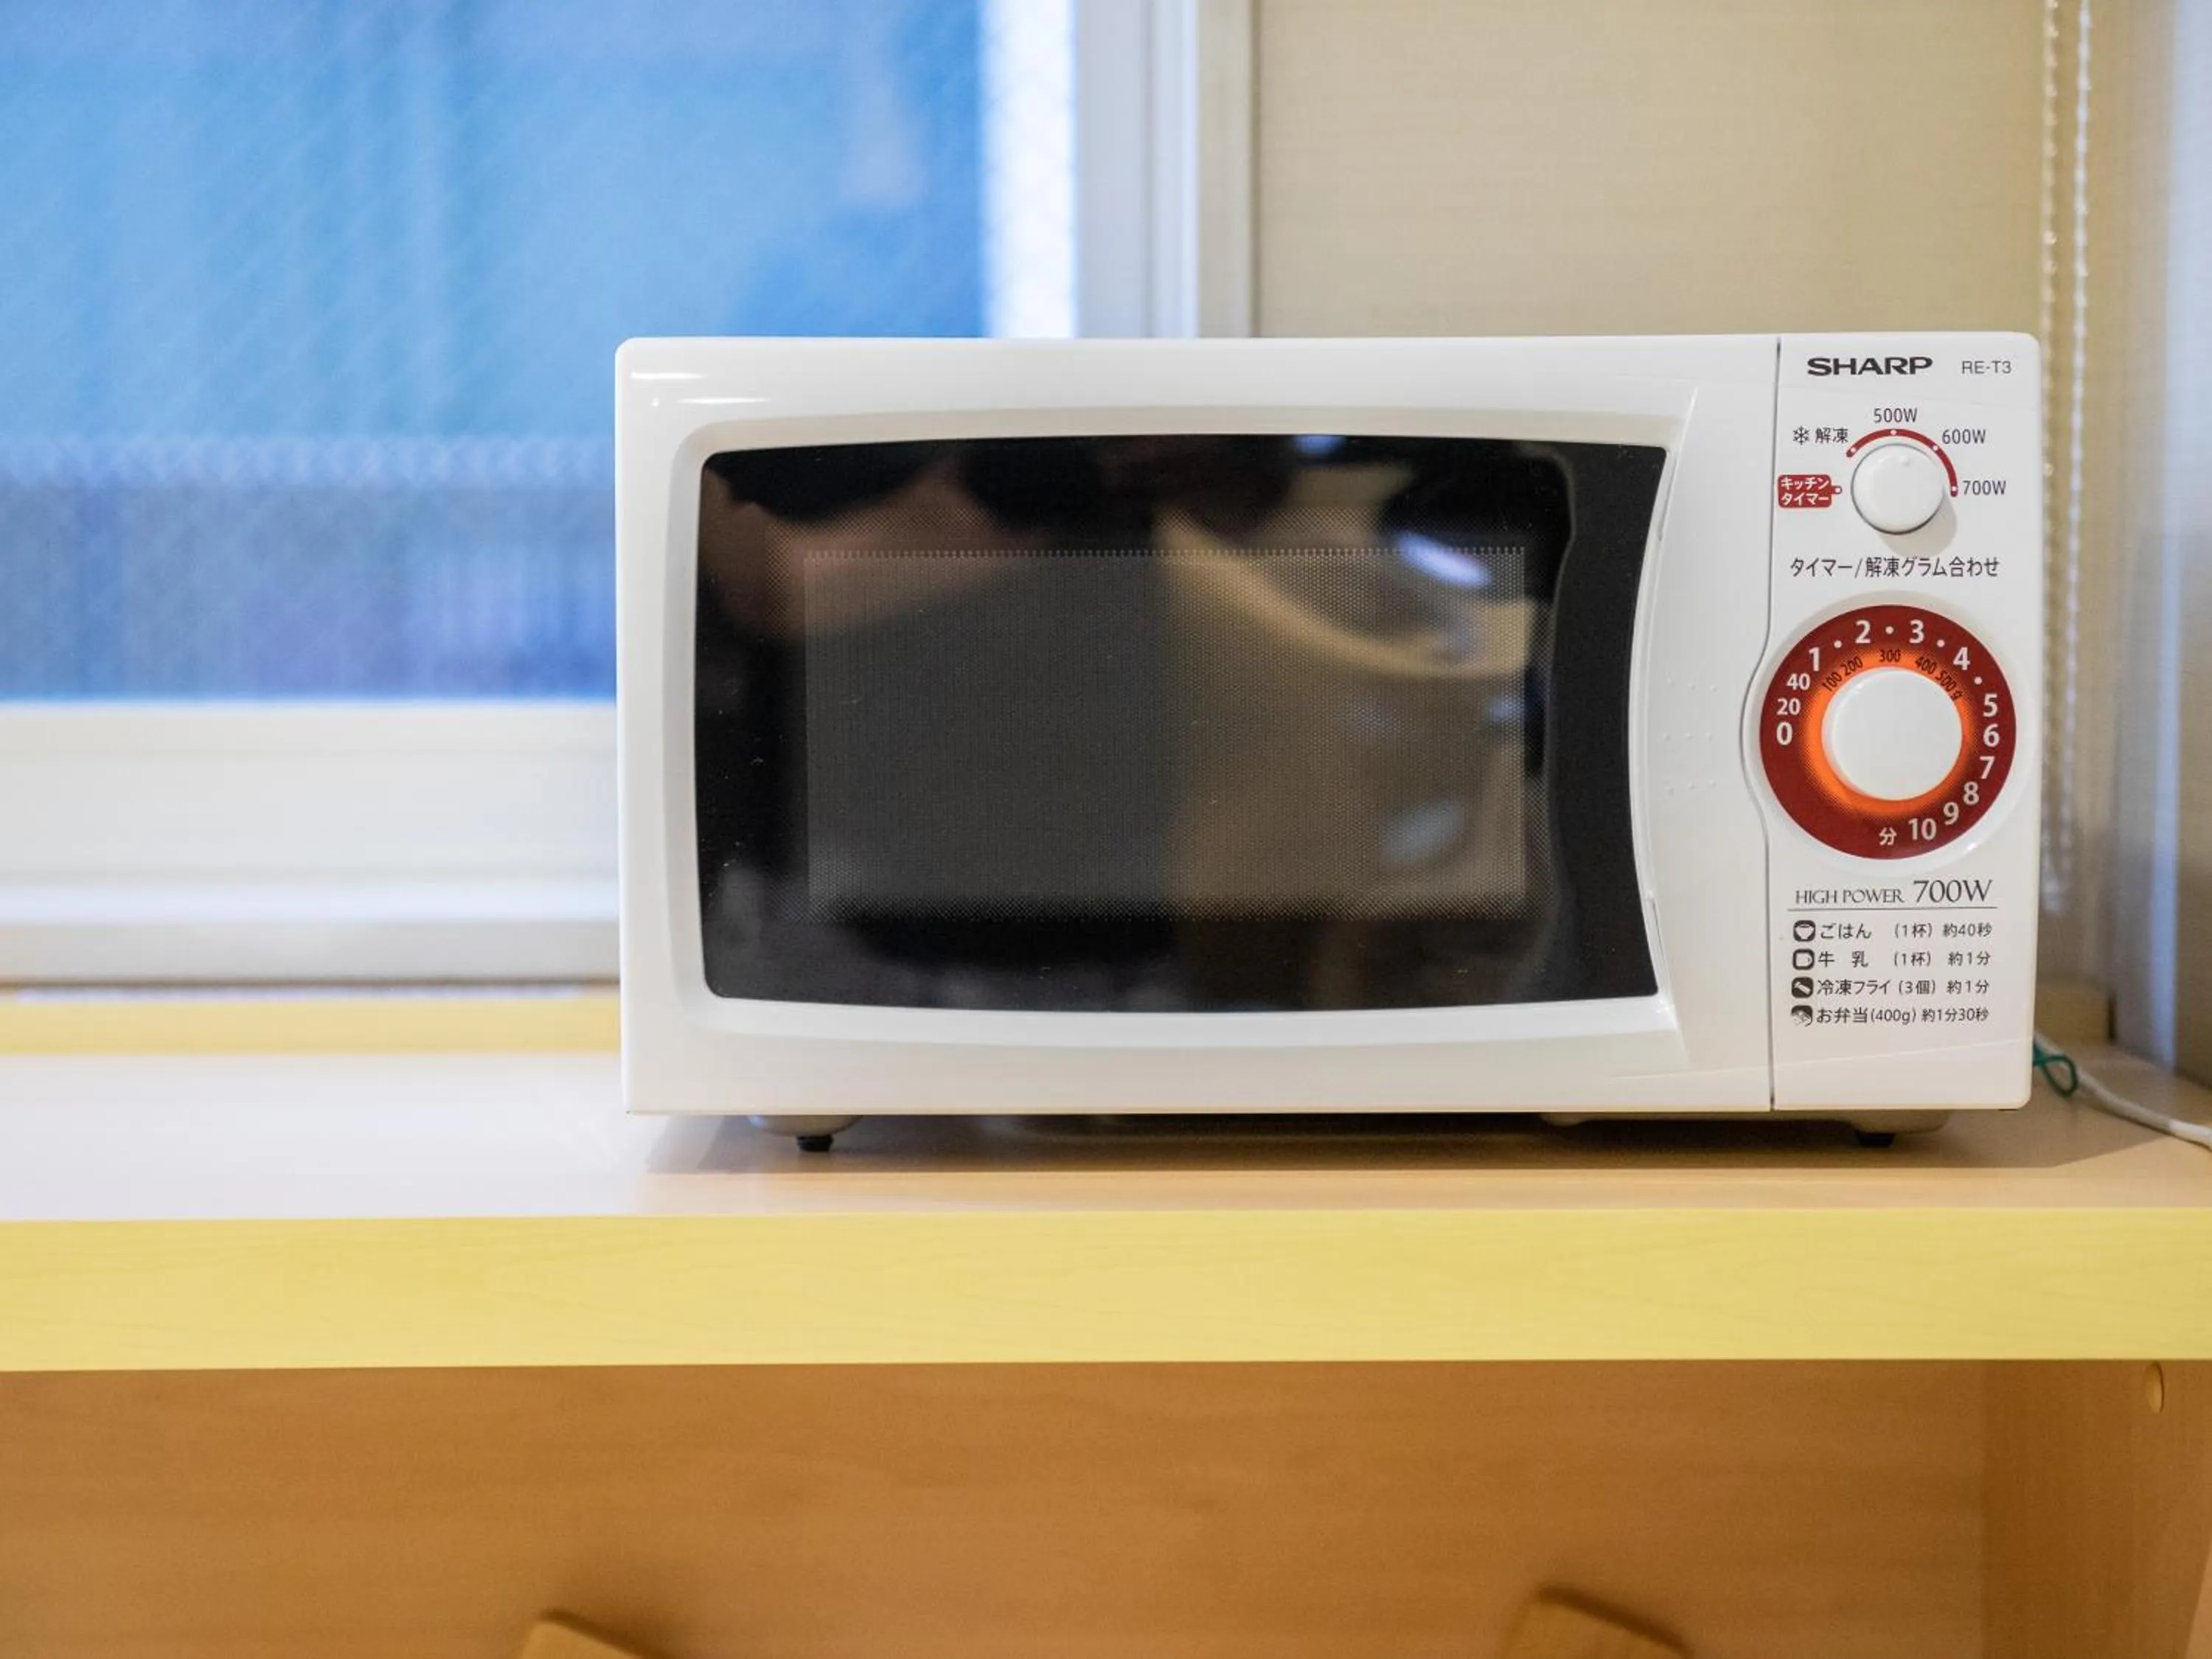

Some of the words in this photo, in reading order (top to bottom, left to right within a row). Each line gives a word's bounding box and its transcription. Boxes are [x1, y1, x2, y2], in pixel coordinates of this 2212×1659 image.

[1807, 357, 1933, 376] SHARP
[1962, 361, 2011, 374] RE-T3
[1874, 408, 1917, 423] 500W
[1942, 428, 1986, 445] 600W
[1780, 477, 1829, 490] キッチン
[1963, 480, 2006, 495] 700W
[1780, 493, 1829, 506] タイマー
[1856, 620, 1870, 643] 2
[1910, 620, 1924, 643] 3
[1809, 647, 1820, 672] 1
[1953, 647, 1970, 670] 4
[1822, 672, 1842, 691] 100
[1840, 655, 1863, 675] 200
[1879, 649, 1901, 662] 300
[1916, 656, 1937, 674] 400
[1787, 673, 1810, 690] 40
[1777, 698, 1801, 715] 20
[1983, 694, 1997, 717] 5
[1777, 722, 1792, 745] 0
[1983, 723, 2000, 747] 6
[1980, 757, 1994, 779] 7
[1964, 782, 1979, 804] 8
[1944, 802, 1959, 825] 9
[1879, 828, 1896, 845] 分
[1909, 818, 1936, 840] 10
[1796, 890, 1837, 904] HIGH
[1843, 889, 1904, 903] POWER
[1913, 880, 1992, 902] 700W
[1820, 923, 1871, 939] ごはん
[1943, 922, 1992, 937] 約40秒
